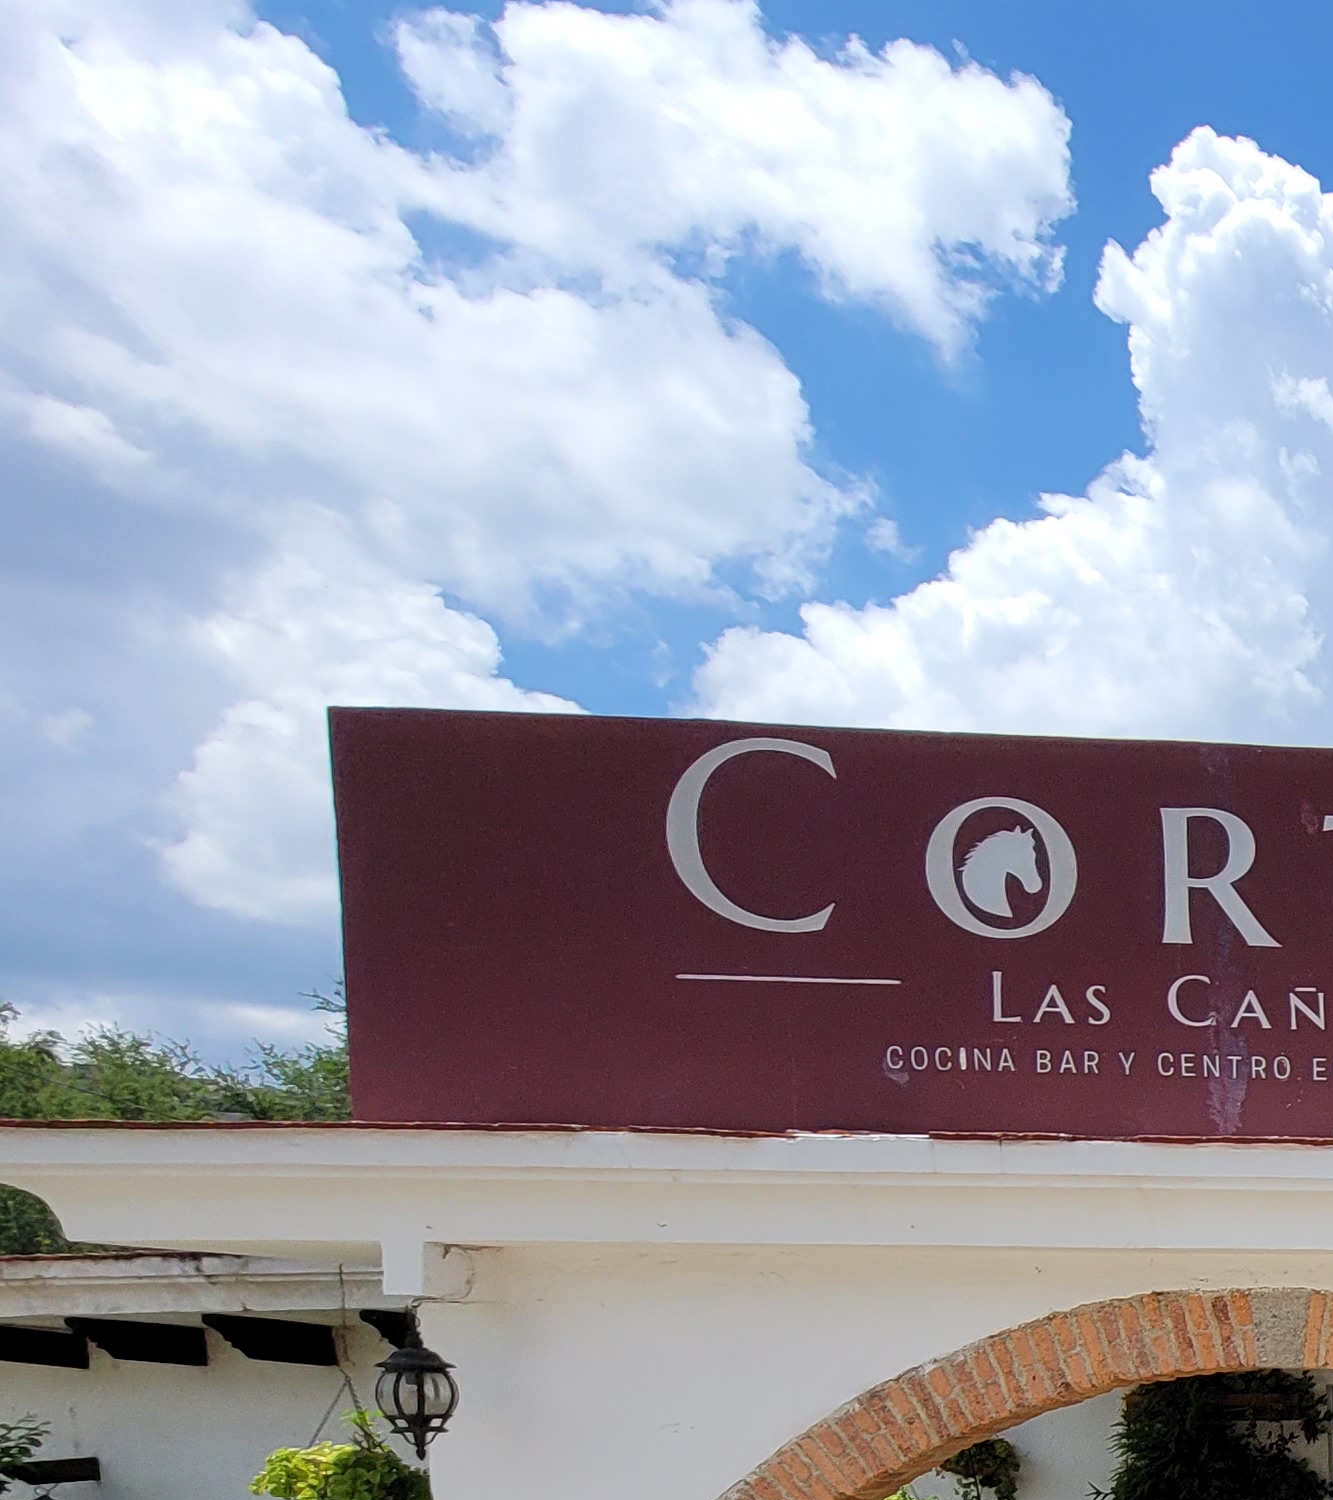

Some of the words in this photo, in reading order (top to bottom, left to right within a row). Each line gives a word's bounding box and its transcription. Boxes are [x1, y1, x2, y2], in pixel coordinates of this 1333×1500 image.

[991, 971, 1111, 1025] LAS
[885, 1046, 1017, 1073] COCINA
[1035, 1050, 1101, 1075] BAR
[1118, 1052, 1136, 1076] Y
[1157, 1052, 1292, 1080] CENTRO
